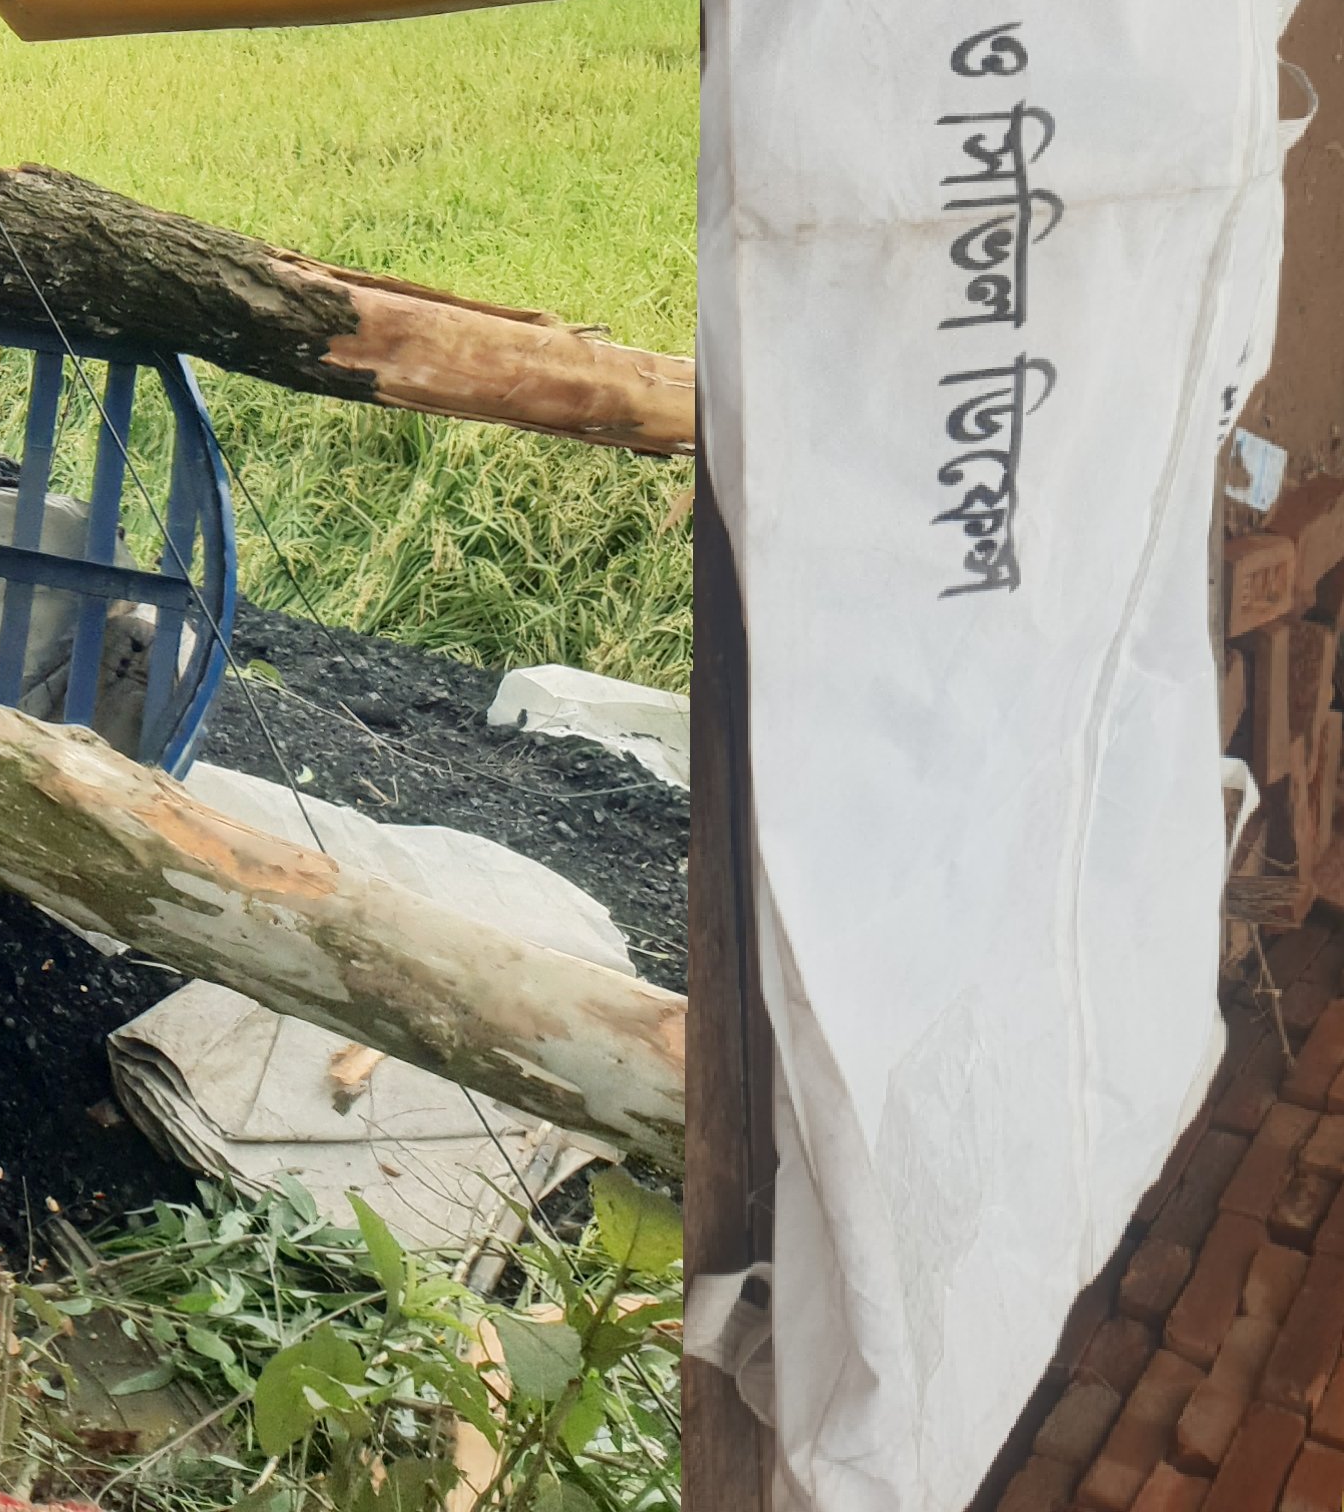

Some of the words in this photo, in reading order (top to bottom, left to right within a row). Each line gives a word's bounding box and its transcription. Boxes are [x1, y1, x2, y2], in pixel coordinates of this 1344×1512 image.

[950, 21, 1029, 77] ও
[934, 99, 1065, 330] সিভিল
[930, 352, 1057, 600] ডিফেন্স
